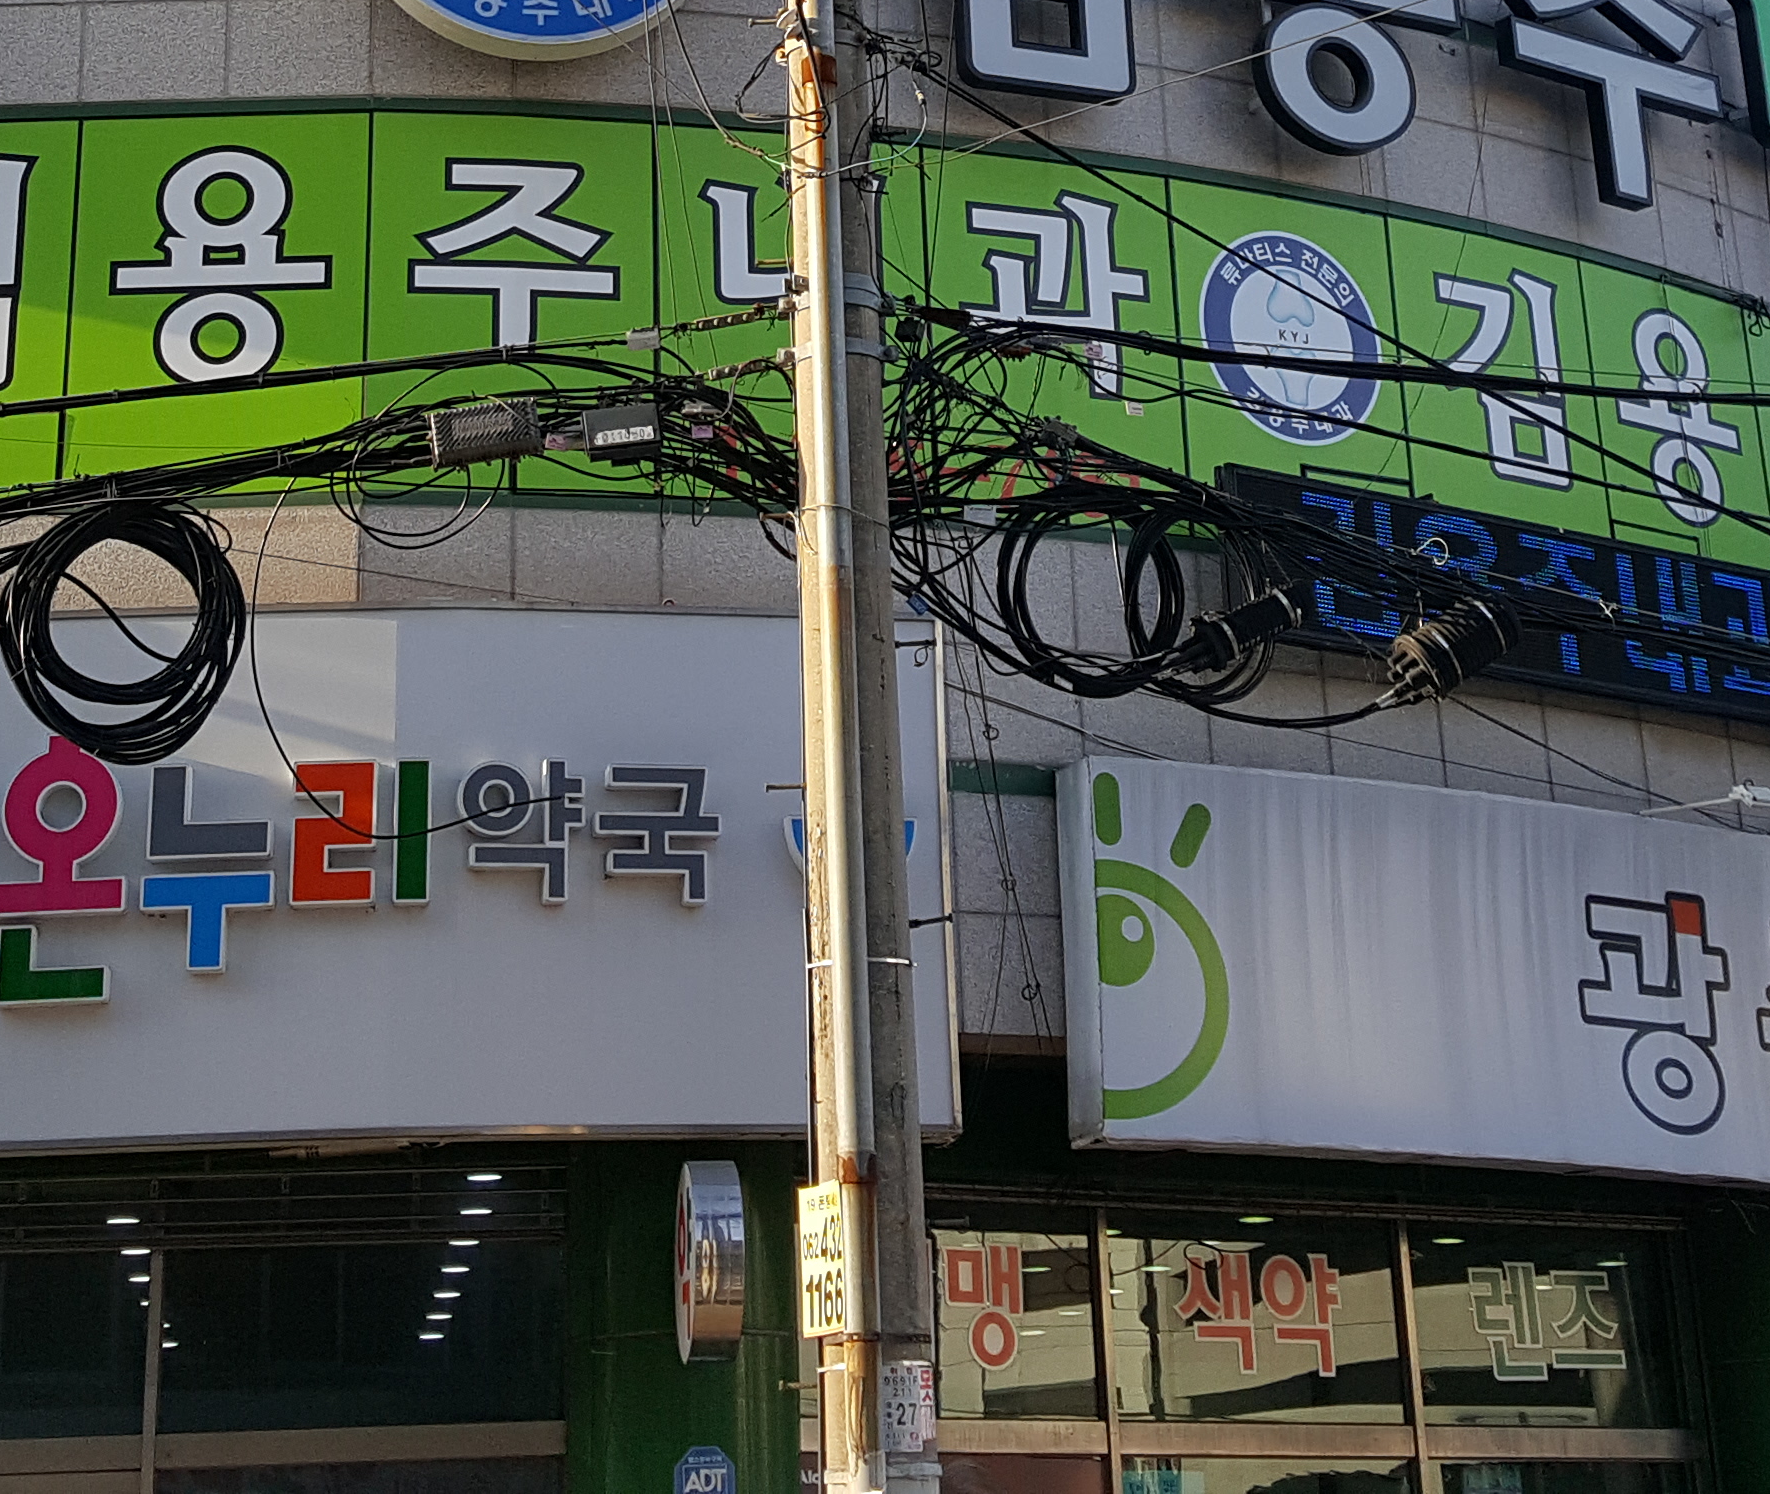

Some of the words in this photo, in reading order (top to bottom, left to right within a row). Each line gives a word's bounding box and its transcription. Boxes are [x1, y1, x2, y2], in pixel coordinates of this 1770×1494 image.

[1301, 248, 1355, 307] 전문의
[805, 1267, 844, 1329] 1166
[1176, 1252, 1343, 1378] 색약
[1466, 1259, 1629, 1382] 렌즈
[684, 1468, 727, 1494] ADT
